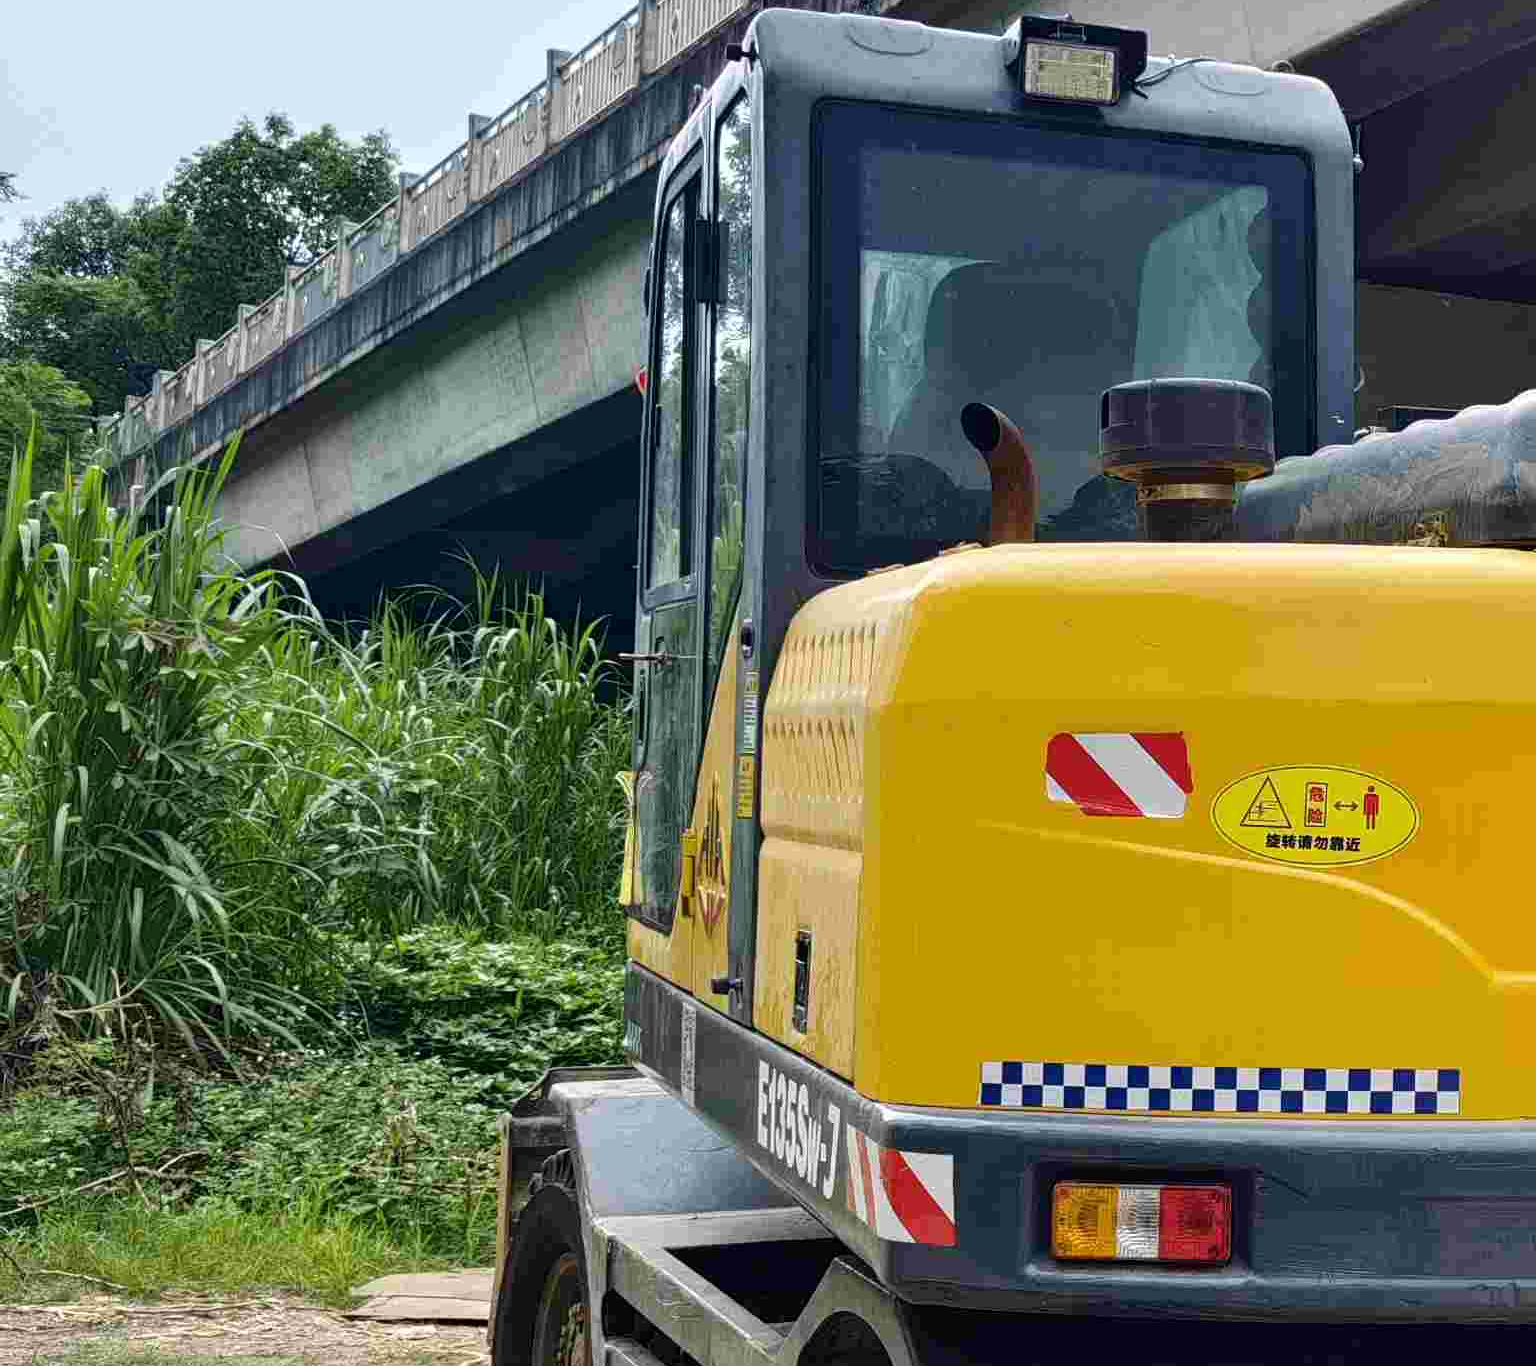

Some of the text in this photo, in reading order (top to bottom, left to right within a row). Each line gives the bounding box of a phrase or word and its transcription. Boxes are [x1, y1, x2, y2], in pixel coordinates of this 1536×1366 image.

[1265, 834, 1361, 852] 旋转请勿靠近
